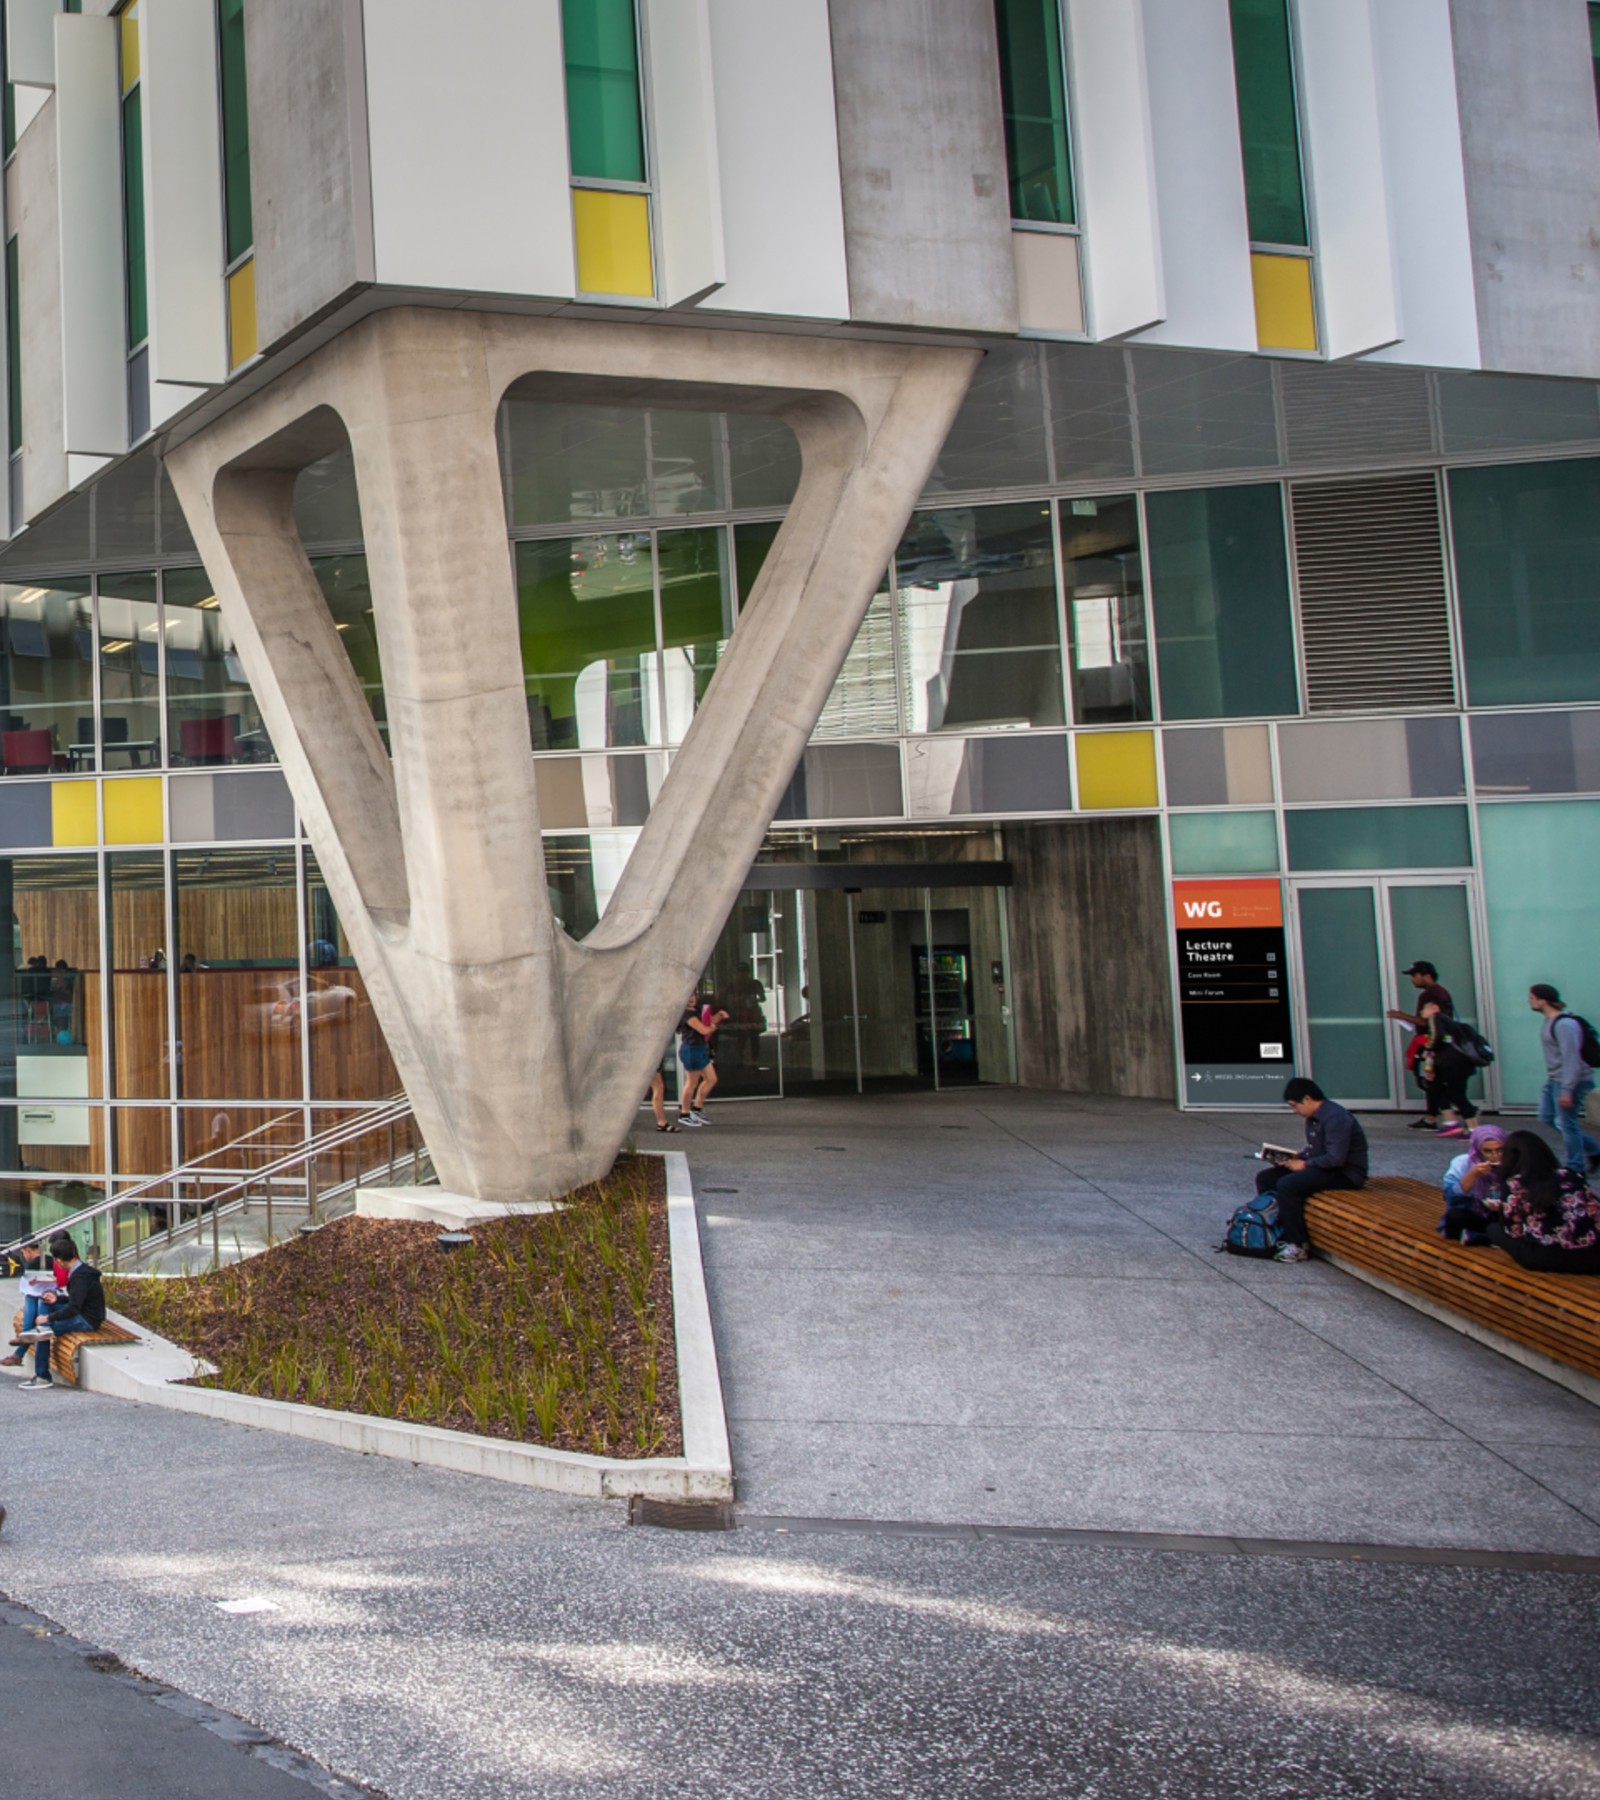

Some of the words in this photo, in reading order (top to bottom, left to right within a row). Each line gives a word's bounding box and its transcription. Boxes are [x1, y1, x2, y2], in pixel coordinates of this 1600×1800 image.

[1183, 901, 1222, 918] WG
[1186, 940, 1232, 950] Lecture
[1186, 952, 1234, 962] Theatre
